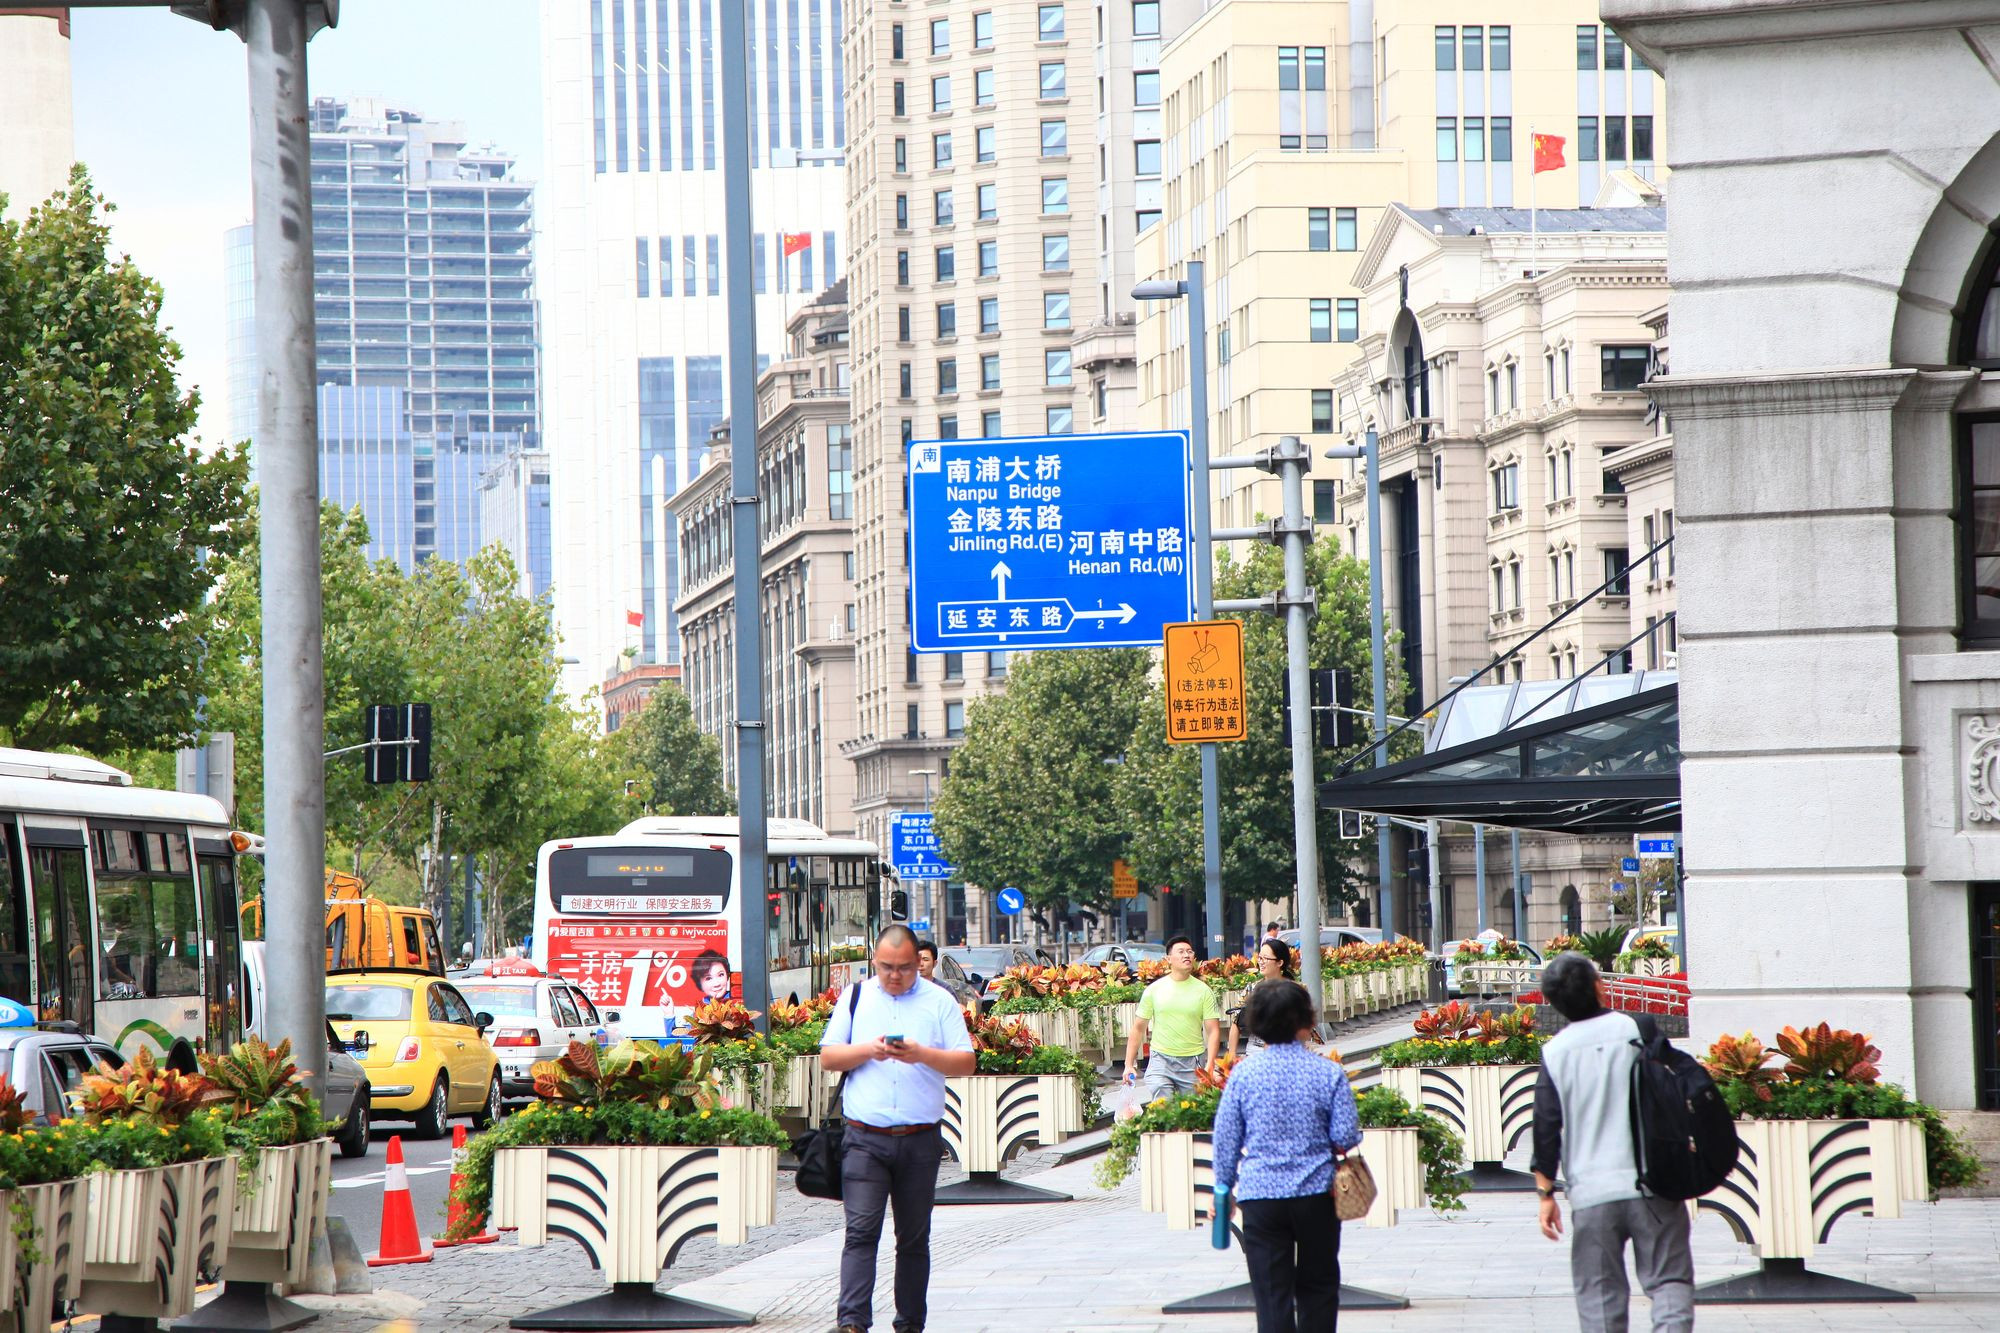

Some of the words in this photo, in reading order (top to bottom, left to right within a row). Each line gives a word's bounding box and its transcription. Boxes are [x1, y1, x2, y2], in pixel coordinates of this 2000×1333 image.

[922, 447, 937, 462] 南
[946, 454, 1062, 483] 南浦大桥
[946, 486, 998, 504] Nanpu
[1009, 483, 1061, 502] Bridge
[947, 504, 1063, 533] 金陵东路
[948, 535, 1007, 554] Jinling
[1010, 533, 1063, 553] Rd.(E)
[1068, 526, 1183, 556] 河南中路
[1068, 559, 1121, 575] Henan
[1129, 556, 1183, 576] Rd.(M)
[1096, 599, 1103, 609] 1
[947, 606, 1063, 629] 延安东路
[1097, 620, 1104, 629] 2
[1172, 696, 1239, 713] 停车行为违法
[1176, 716, 1238, 733] 请立即驶离
[570, 898, 638, 910] 创建文明行业
[645, 898, 713, 910] 保障安全服务
[603, 927, 679, 937] DAEWOO
[682, 927, 727, 938] iwjw.com
[559, 950, 623, 975] 二手房
[623, 949, 688, 1006] 1%
[567, 977, 622, 1001] 金共
